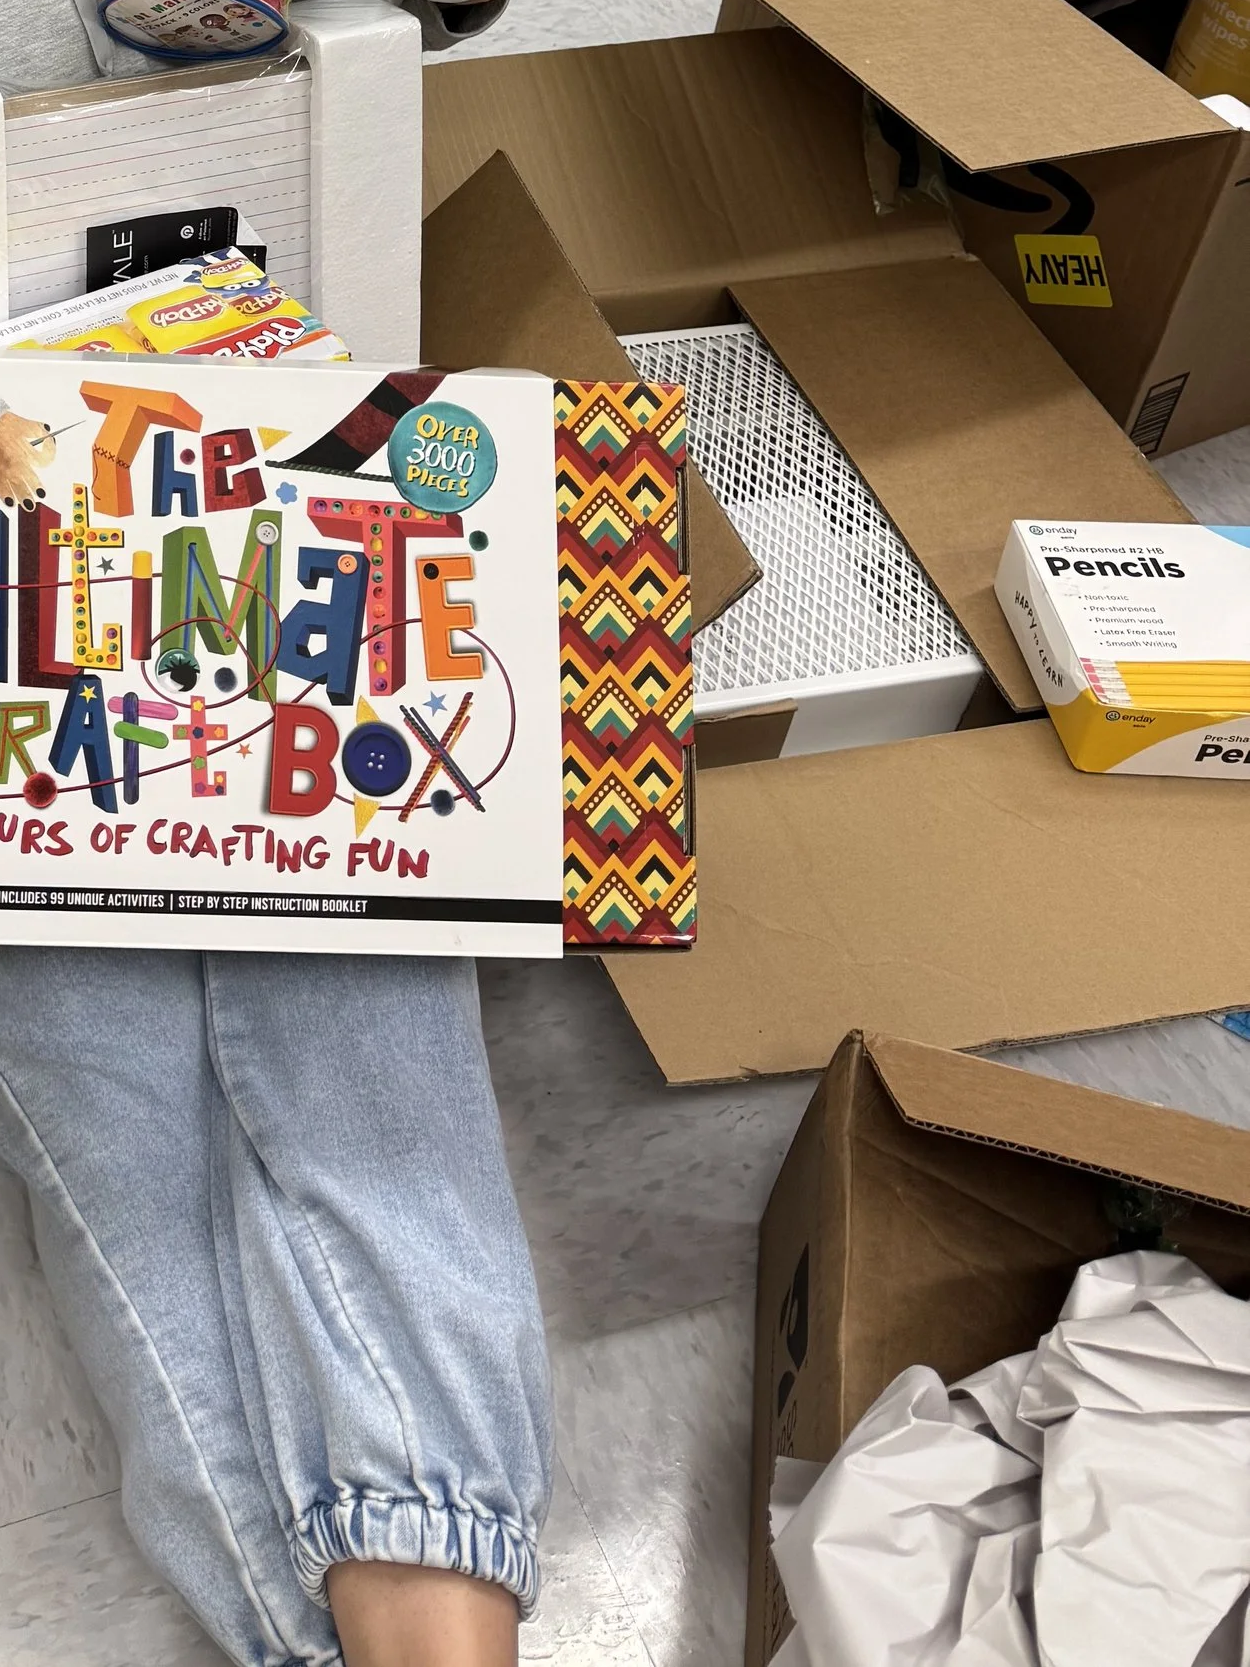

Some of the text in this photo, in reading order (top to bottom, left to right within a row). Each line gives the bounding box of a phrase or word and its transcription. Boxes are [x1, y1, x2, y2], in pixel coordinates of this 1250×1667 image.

[1202, 12, 1248, 51] wipes
[112, 230, 133, 284] ALE
[1025, 253, 1108, 288] HEAVY
[163, 272, 179, 283] NET
[106, 289, 121, 300] NET
[122, 282, 146, 295] POIDS
[82, 298, 93, 306] LA
[93, 295, 106, 304] DE
[9, 323, 21, 332] DE
[416, 413, 480, 450] OVER
[78, 379, 267, 519] The
[406, 434, 476, 478] 3000
[406, 464, 470, 498] PIECES
[1045, 526, 1077, 535] enday
[1040, 545, 1126, 555] Pre-Sharpened
[1146, 547, 1165, 555] HB
[1044, 556, 1186, 579] Pencils
[1090, 605, 1156, 613] Pre-sharpened
[1137, 617, 1164, 625] wood
[1014, 590, 1065, 688] HAPPY LEARN
[1148, 629, 1176, 637] Eraser
[1105, 639, 1178, 649] Smooth Writing
[1121, 713, 1157, 725] enday
[266, 691, 486, 825] BOX
[89, 821, 137, 855] OF
[146, 818, 331, 874] CRAFTING
[347, 837, 431, 879] FUN
[49, 892, 65, 906] 99
[66, 892, 105, 908] UNIQUE
[107, 894, 164, 909] ACTIVITIES
[177, 895, 205, 910] STEP
[206, 895, 220, 910] BY
[222, 896, 249, 911] STEP
[250, 897, 320, 913] INSTRUCTION
[321, 898, 368, 913] BOOKLET
